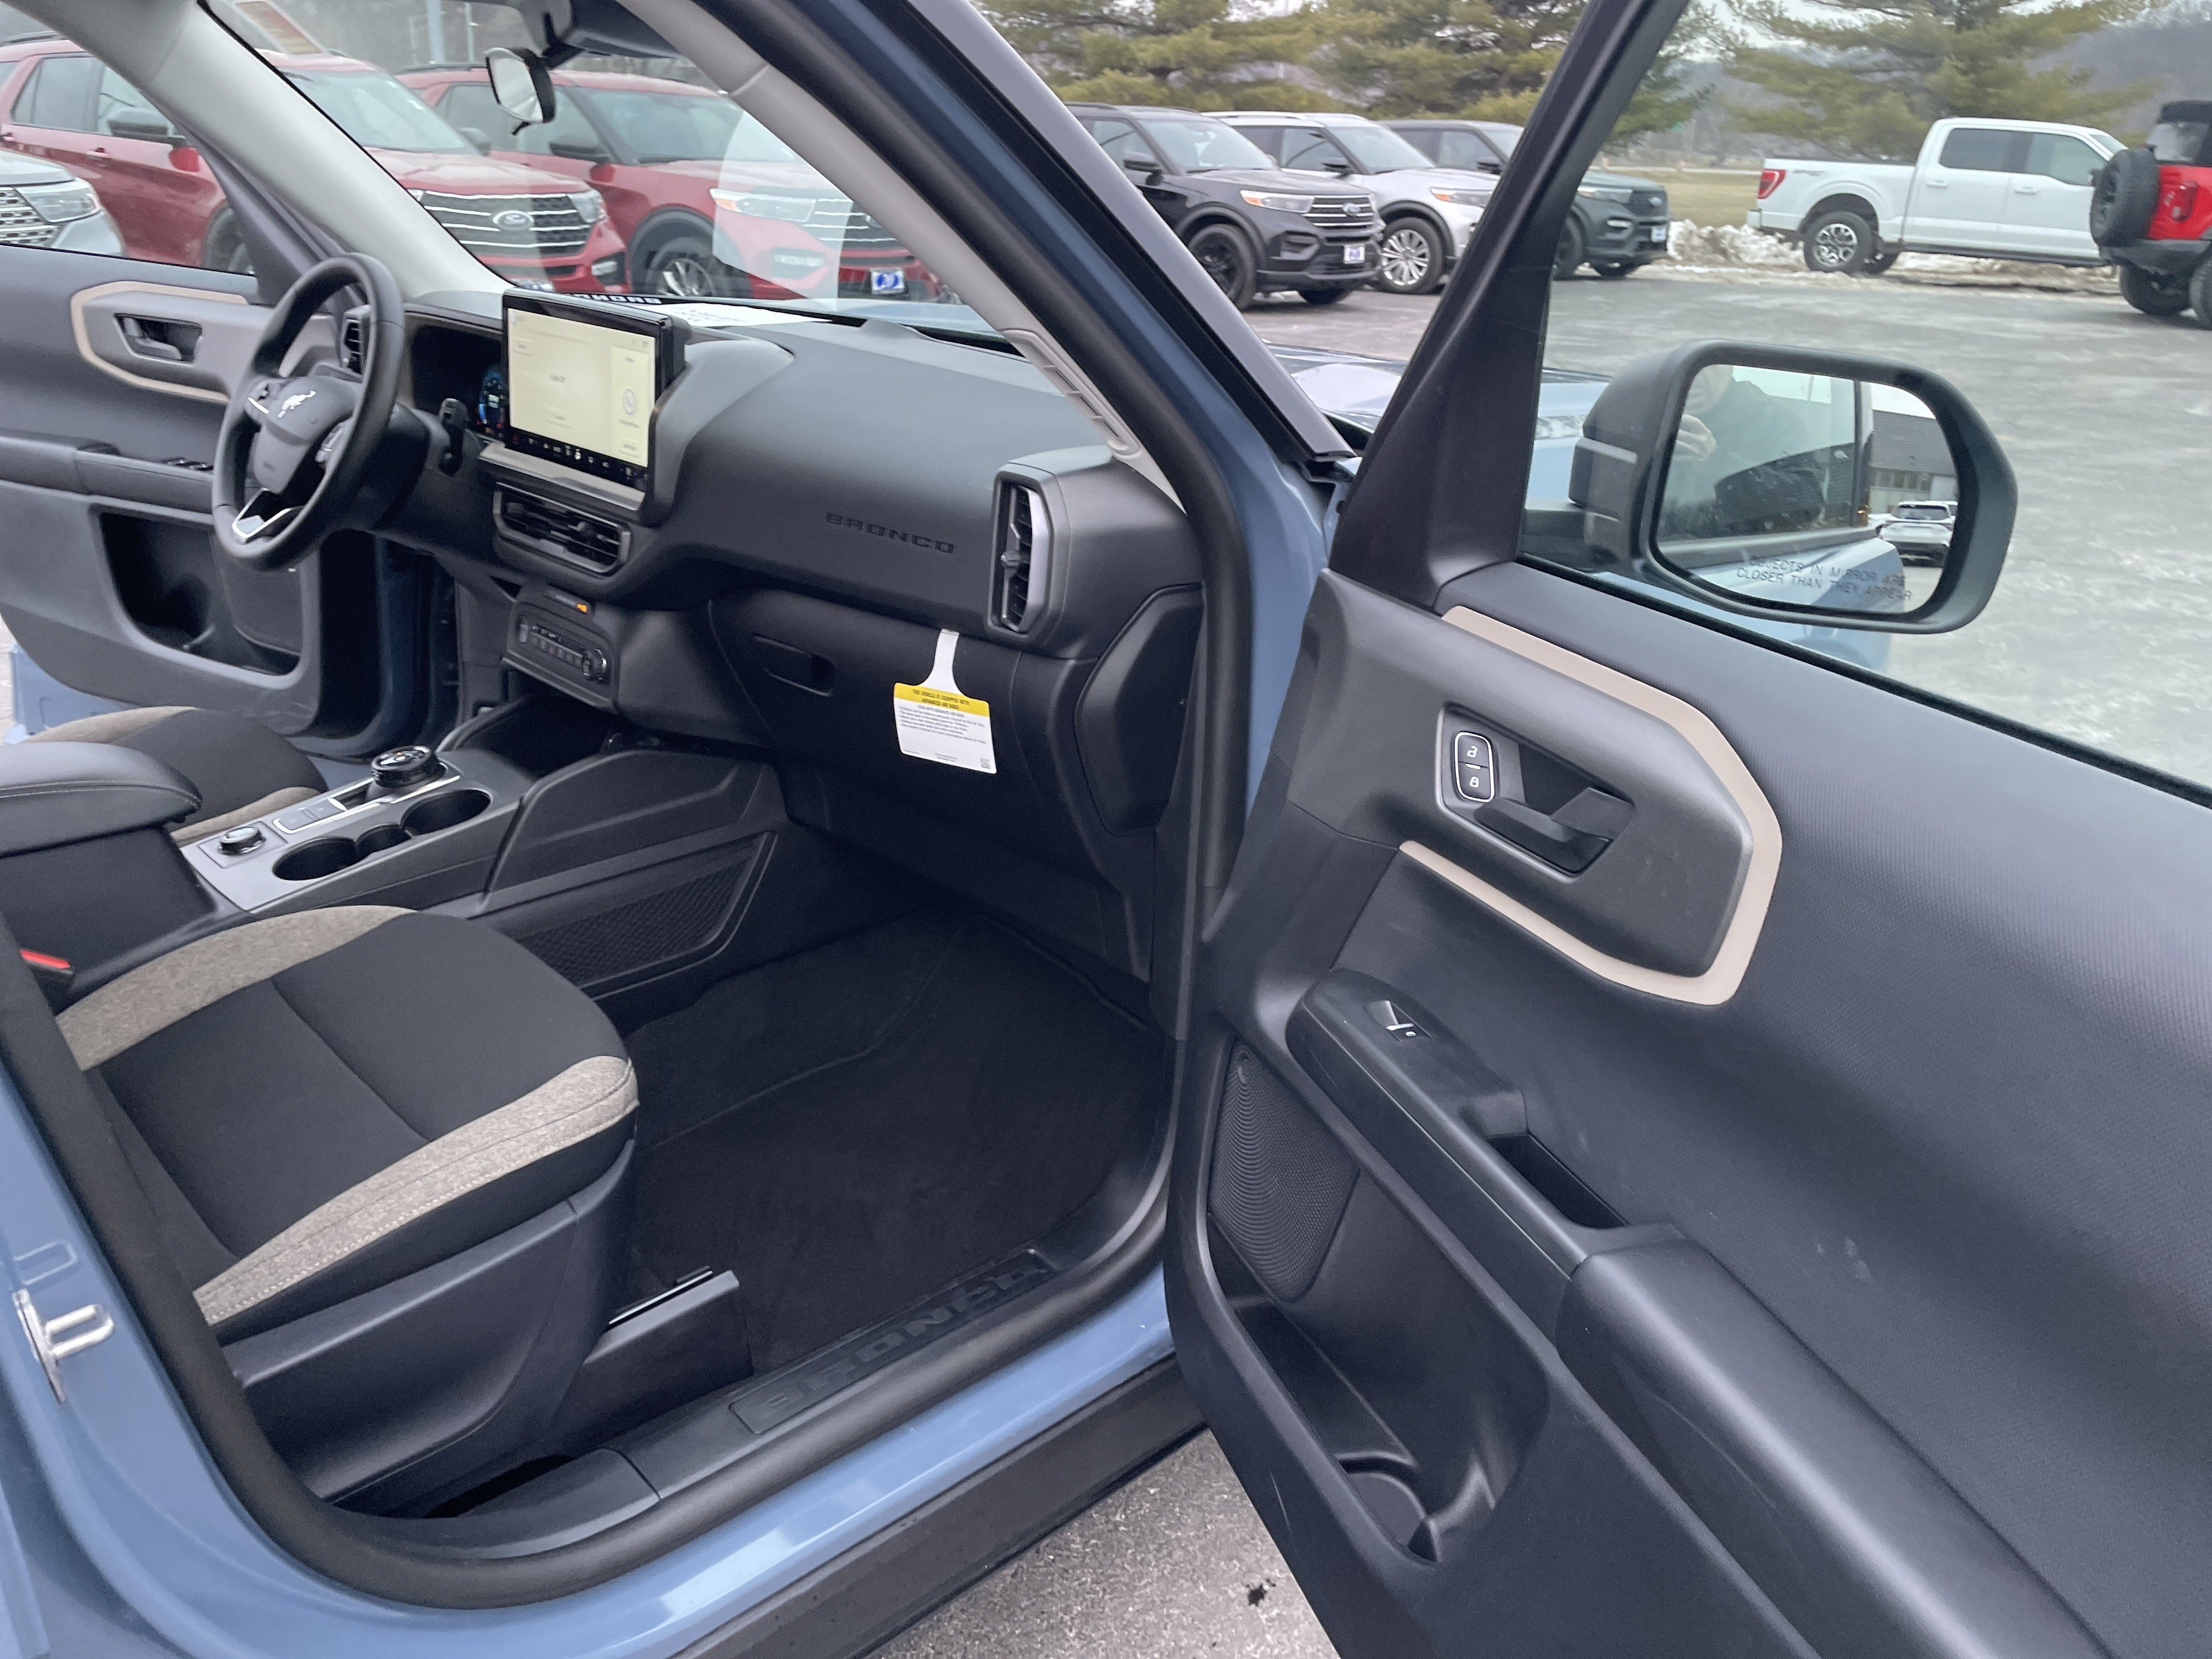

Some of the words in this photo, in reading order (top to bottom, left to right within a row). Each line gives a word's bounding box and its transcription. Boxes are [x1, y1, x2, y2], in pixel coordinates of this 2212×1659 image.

[825, 512, 955, 554] BRONCO
[1736, 567, 1783, 583] CLOSER
[1791, 575, 1822, 589] THAN
[1830, 580, 1860, 593] THEY
[1864, 585, 1912, 601] APPEAR
